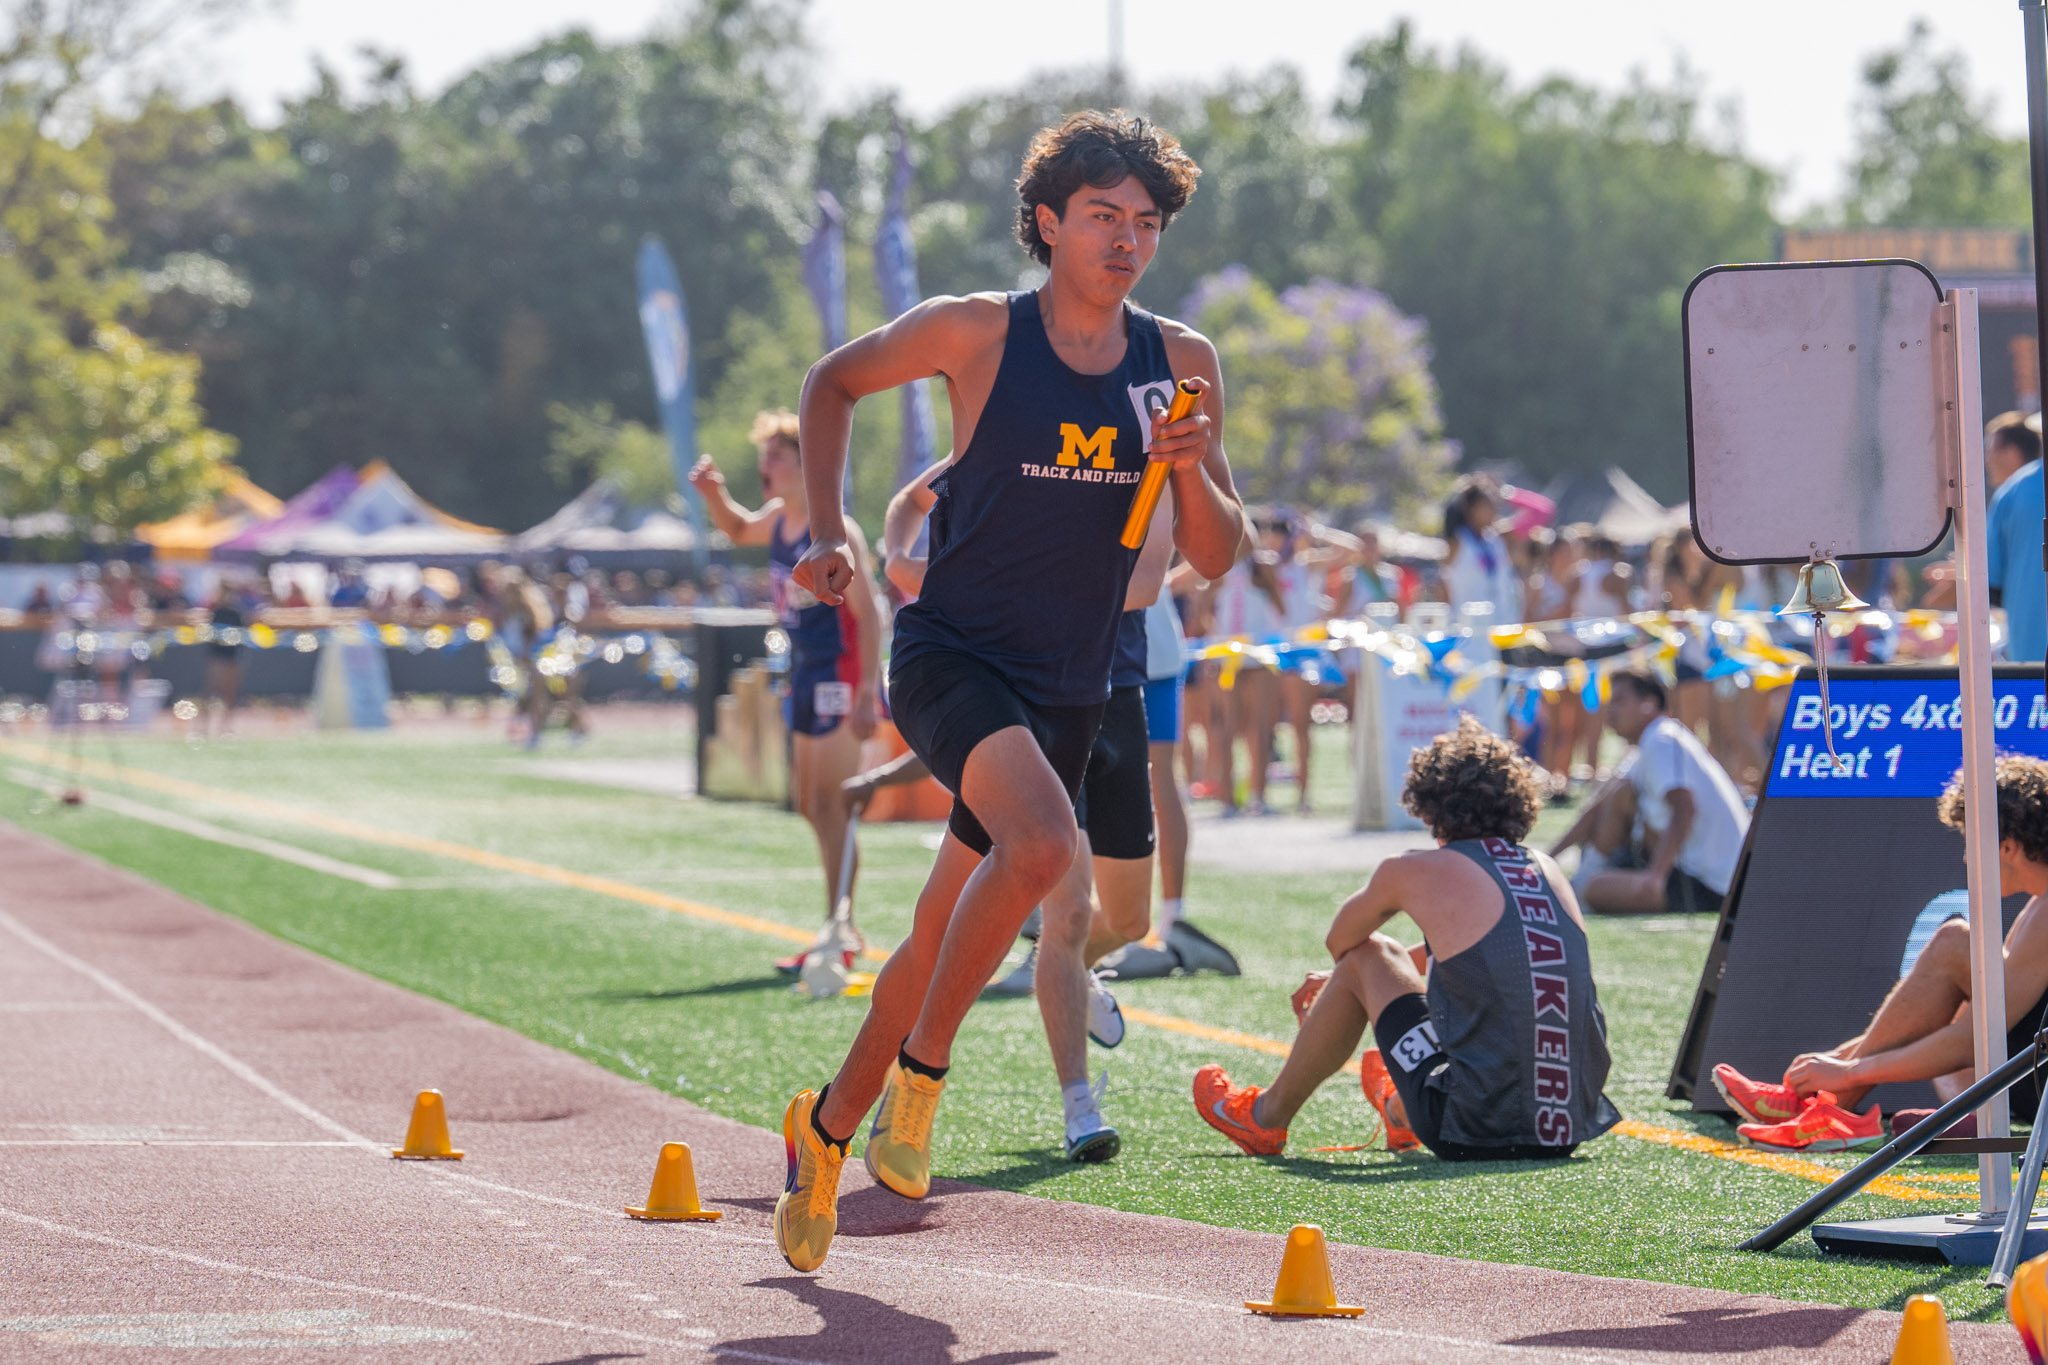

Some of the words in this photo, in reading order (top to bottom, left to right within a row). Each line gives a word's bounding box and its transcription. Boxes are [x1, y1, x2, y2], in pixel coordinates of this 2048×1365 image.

[1056, 422, 1118, 469] M
[1021, 463, 1070, 480] TRACK
[1071, 468, 1103, 483] AND
[1104, 470, 1141, 484] FIELD
[1791, 694, 1892, 739] Boys
[1900, 694, 2019, 730] 4x80
[1779, 743, 1873, 780] Heat
[1883, 743, 1903, 780] 1
